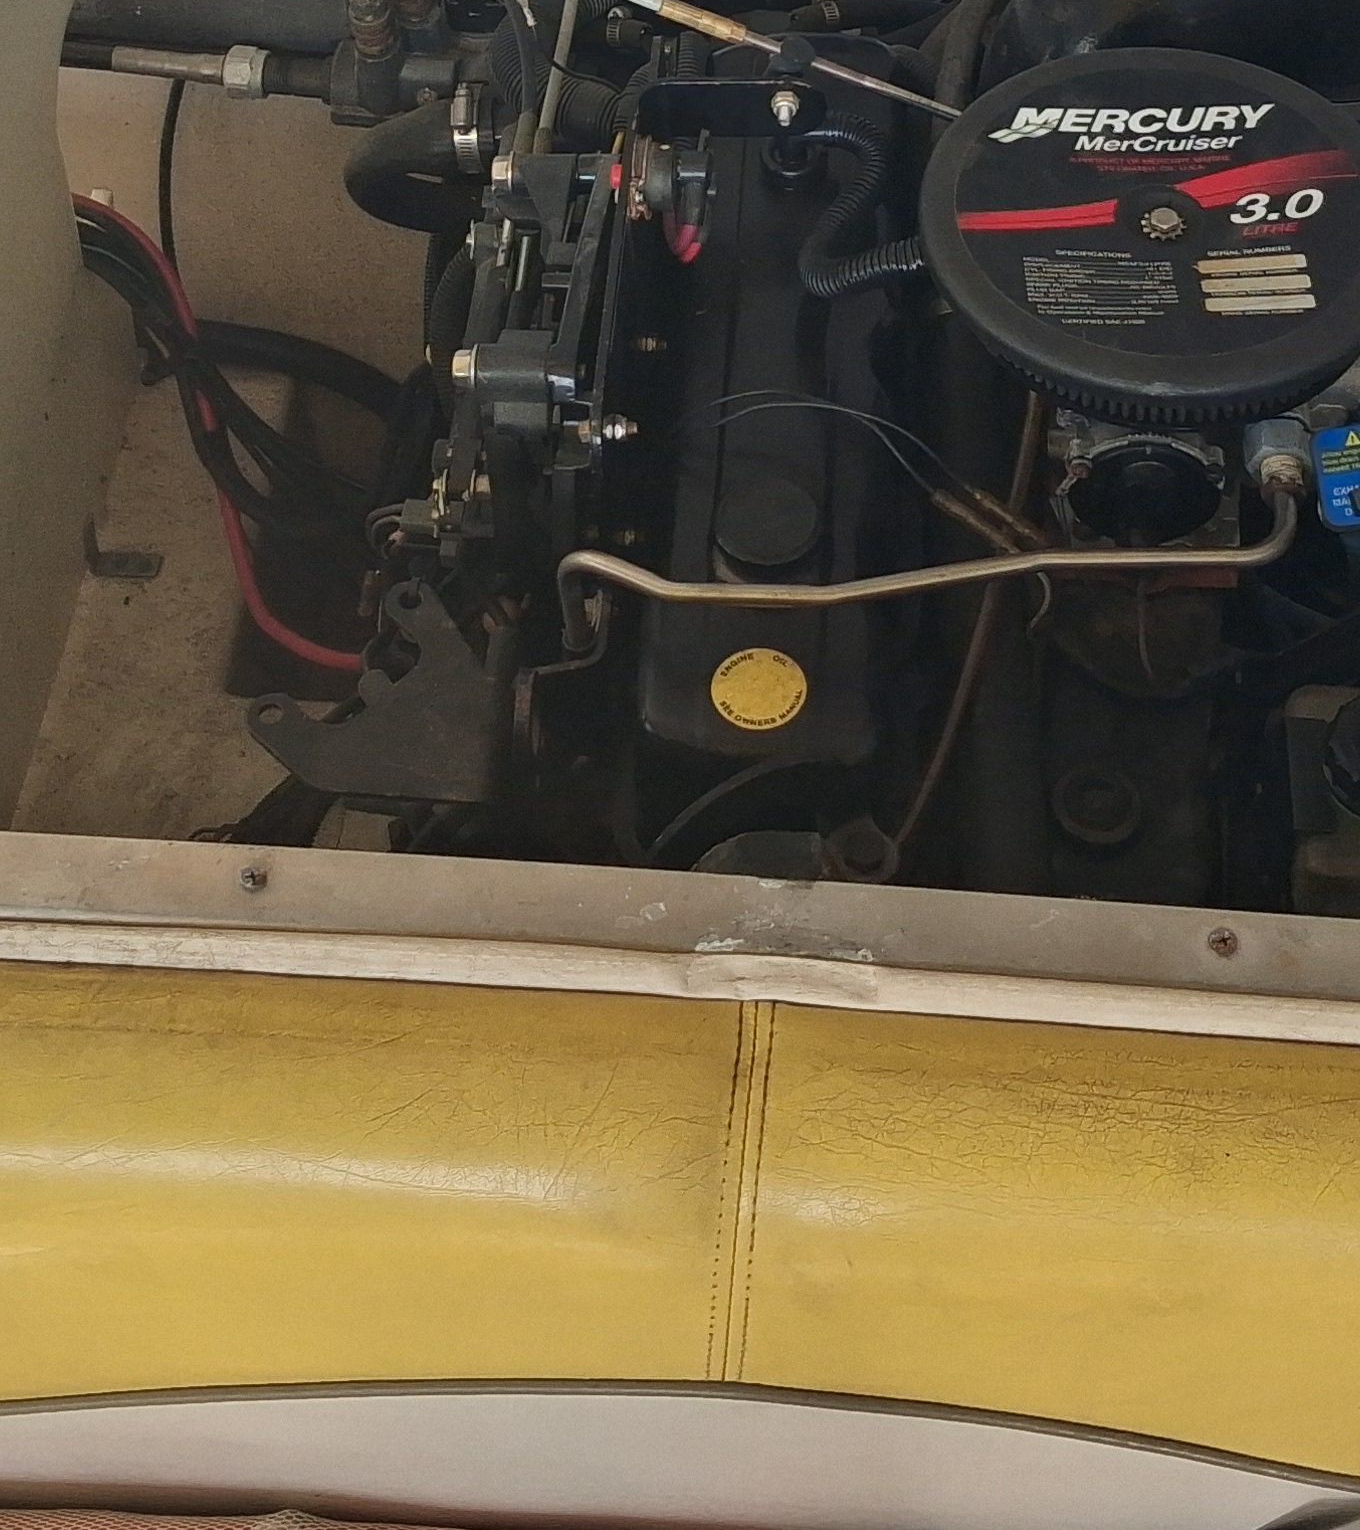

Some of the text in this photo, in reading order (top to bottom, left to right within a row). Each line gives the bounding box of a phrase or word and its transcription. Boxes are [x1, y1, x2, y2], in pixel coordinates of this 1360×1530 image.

[988, 103, 1275, 142] MERCURY
[1074, 134, 1243, 152] MerCruiser
[1229, 188, 1324, 224] 3.0
[1055, 248, 1132, 259] SPECIFICATIONS
[720, 653, 789, 677] ENGINE OIL
[720, 689, 803, 727] SEE OWNERS MANUAL
